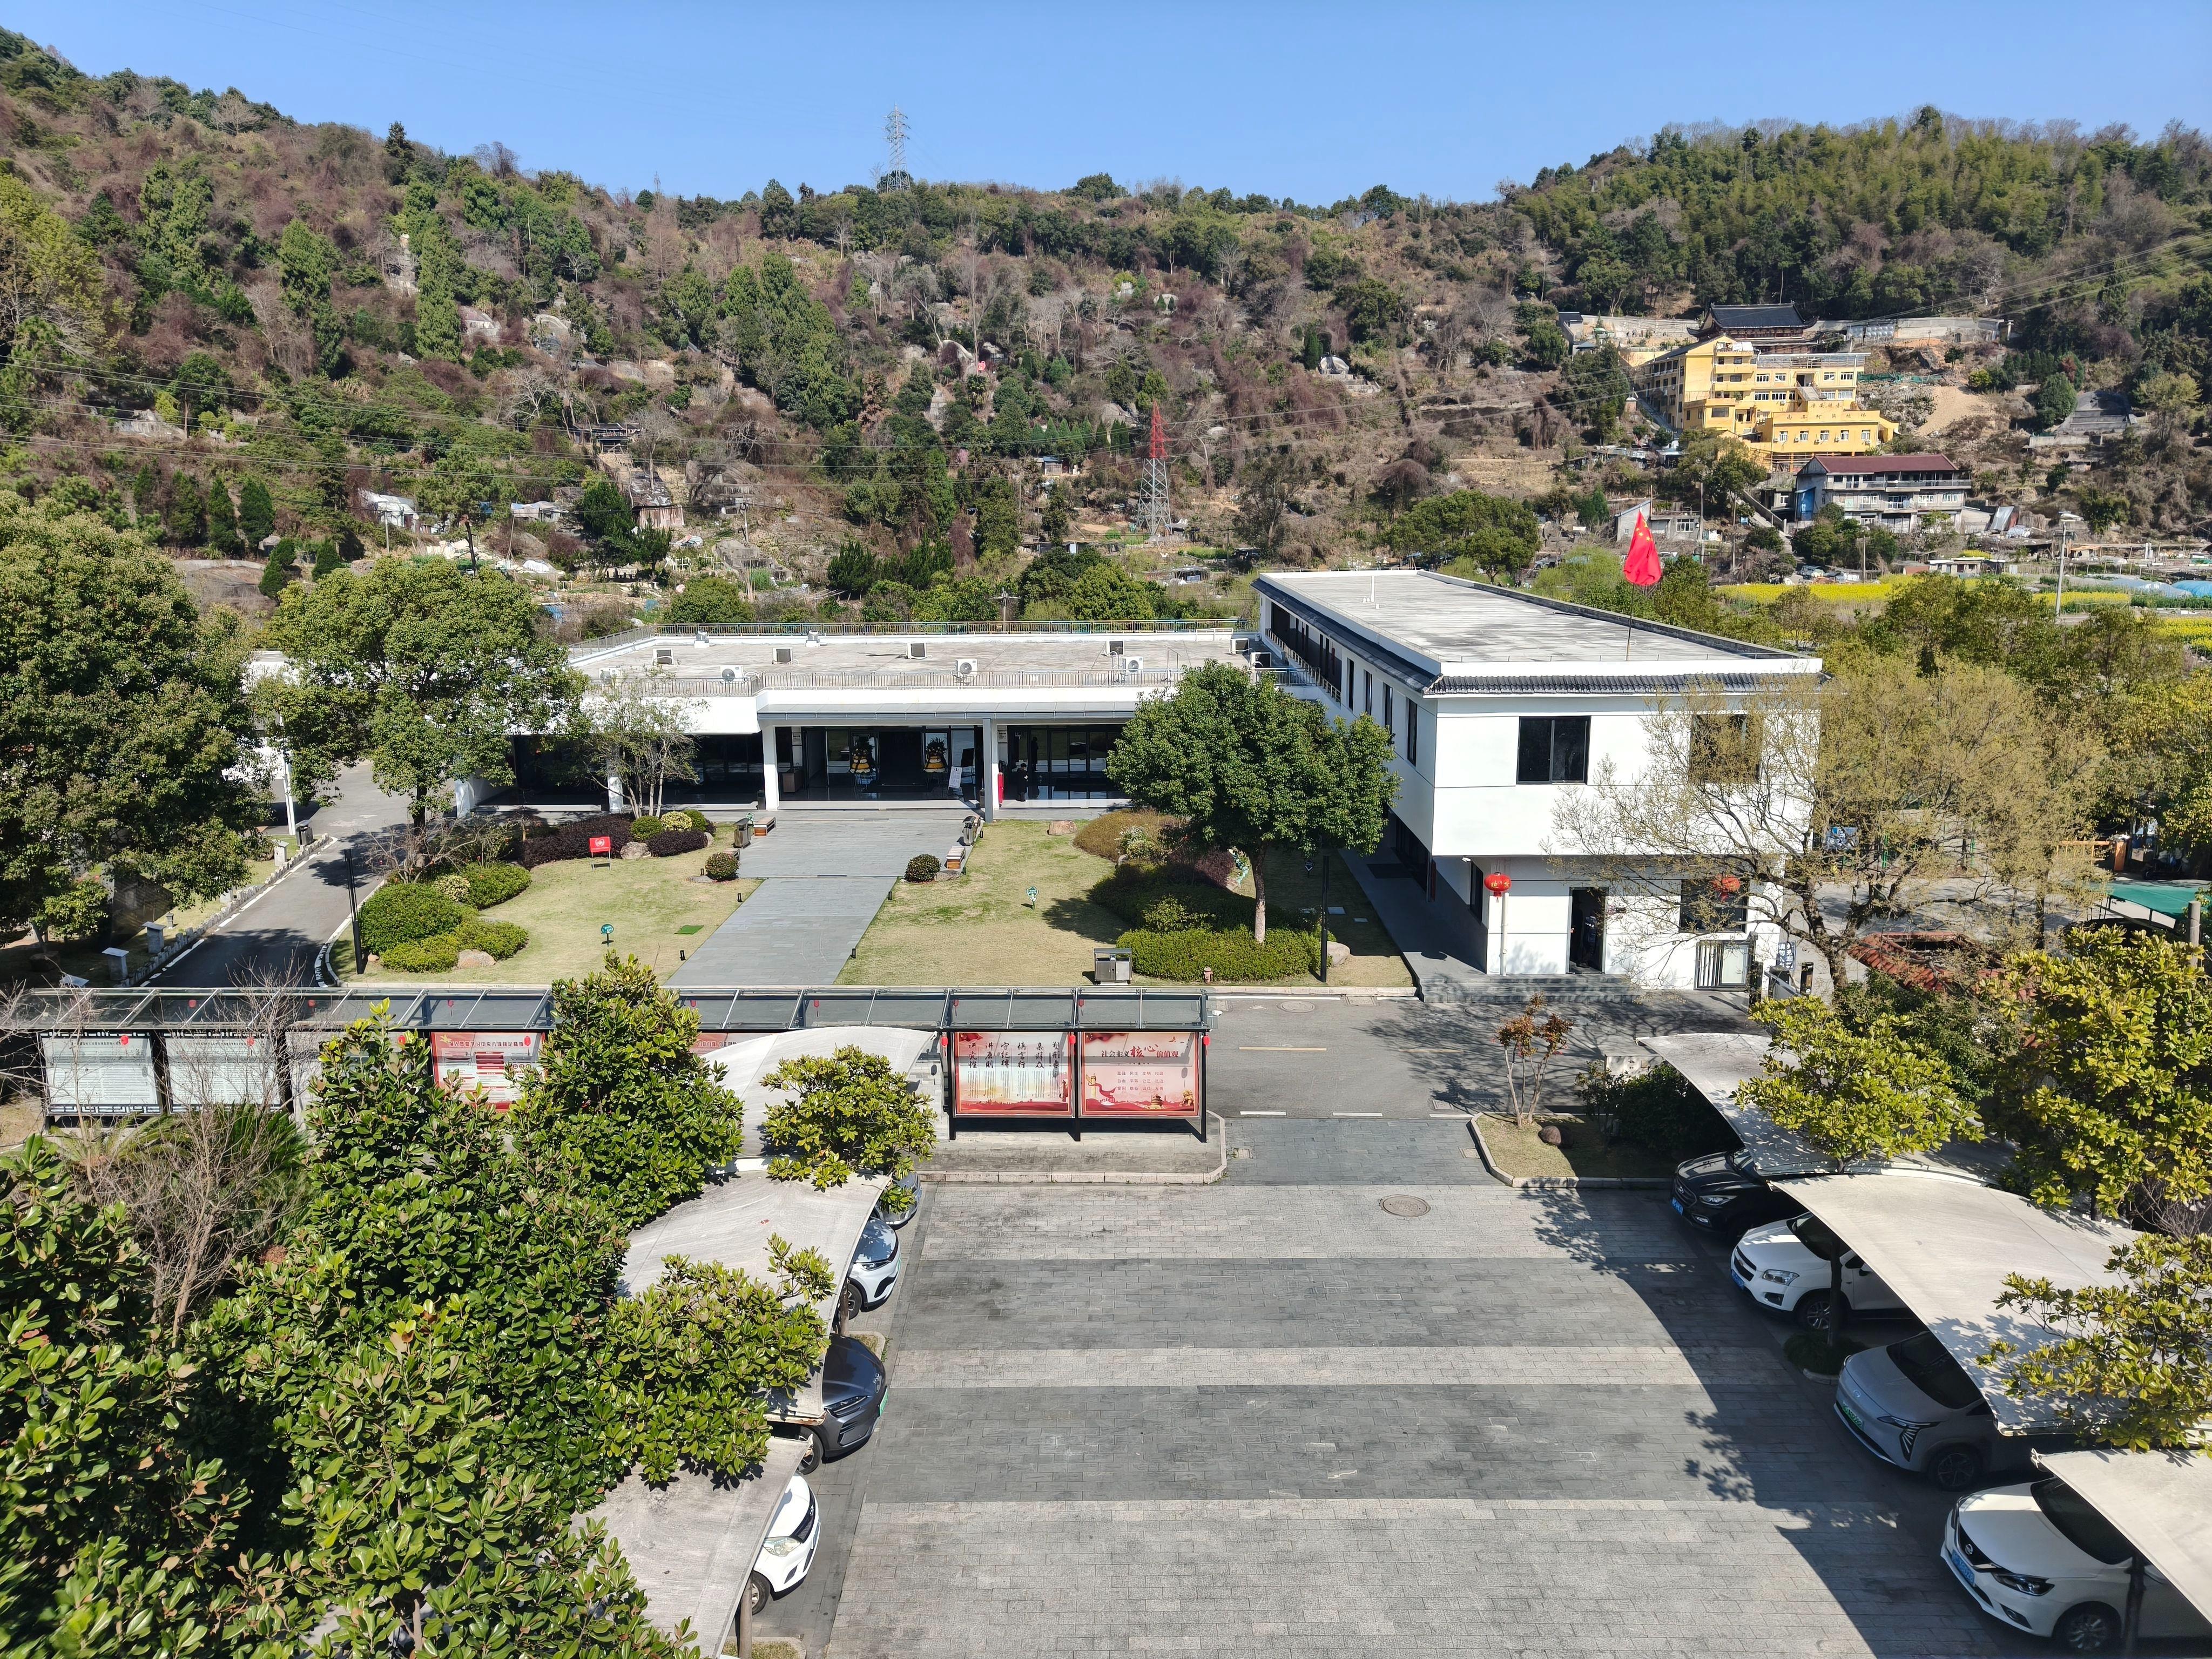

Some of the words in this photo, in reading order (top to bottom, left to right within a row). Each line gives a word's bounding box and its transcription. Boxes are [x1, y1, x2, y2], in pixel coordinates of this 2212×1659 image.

[1001, 1042, 1010, 1069] 守纪律
[1101, 1044, 1178, 1058] 社会主义核心价值观
